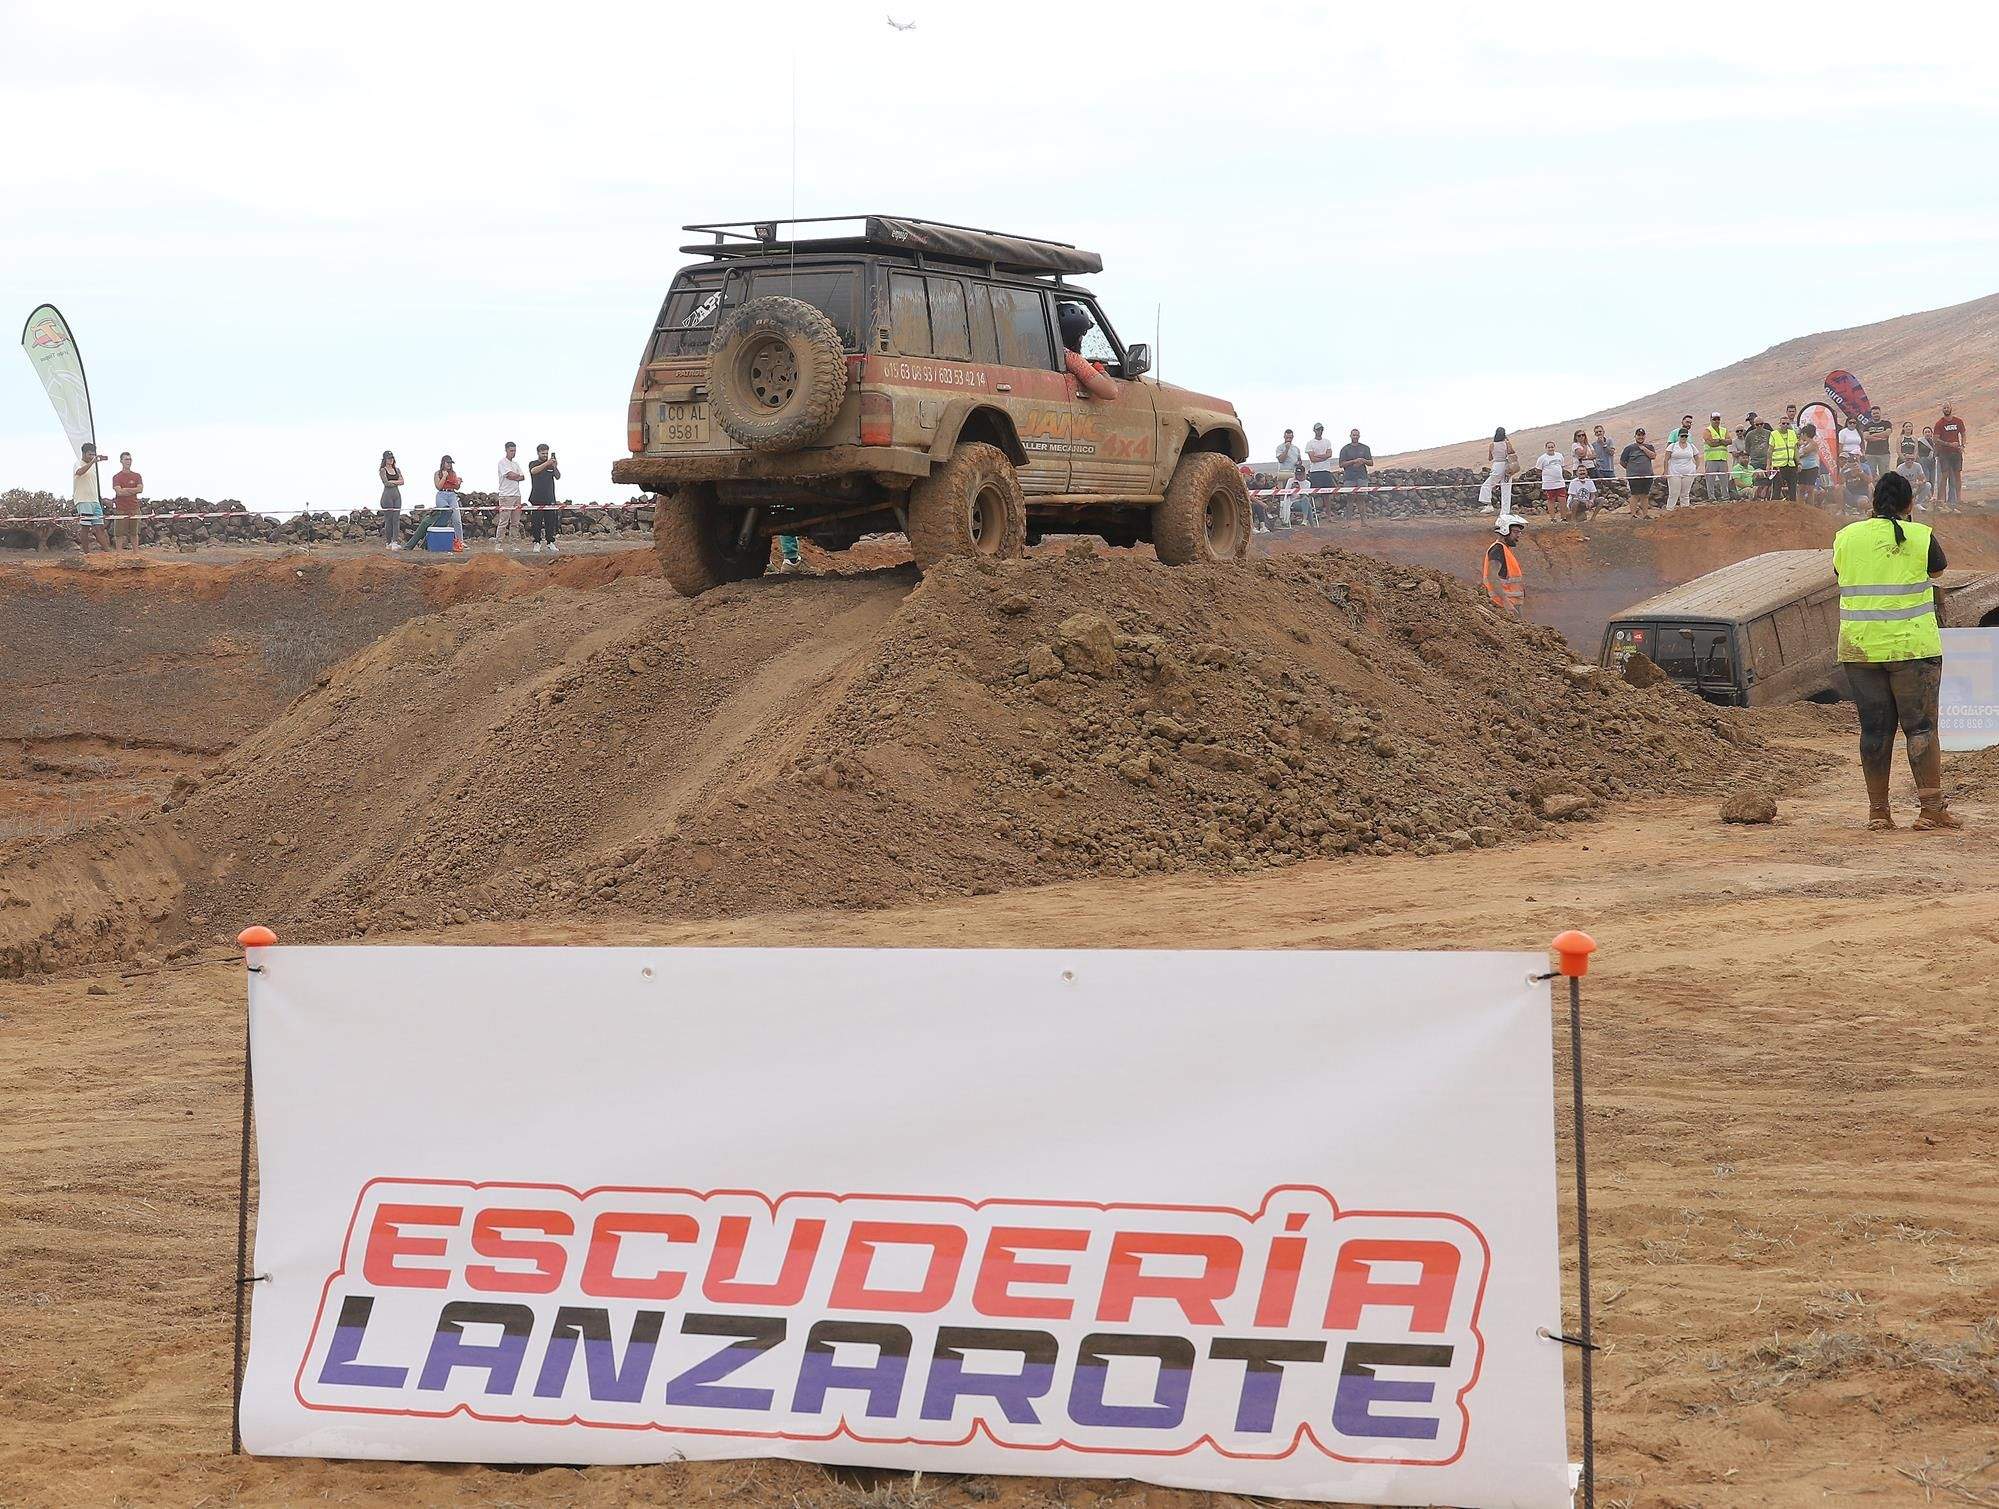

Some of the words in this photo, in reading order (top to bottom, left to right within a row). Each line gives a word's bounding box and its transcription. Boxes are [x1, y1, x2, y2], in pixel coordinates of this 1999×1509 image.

[900, 363, 910, 380] 63
[923, 366, 933, 382] 93
[954, 369, 964, 385] 53
[976, 371, 986, 387] 14
[668, 406, 684, 421] CO
[690, 405, 706, 421] AL
[668, 424, 700, 440] 9581
[1021, 440, 1048, 451] ALLER
[363, 1203, 1462, 1333] ESCUDERÍA
[317, 1295, 1456, 1440] LANZAROTE
